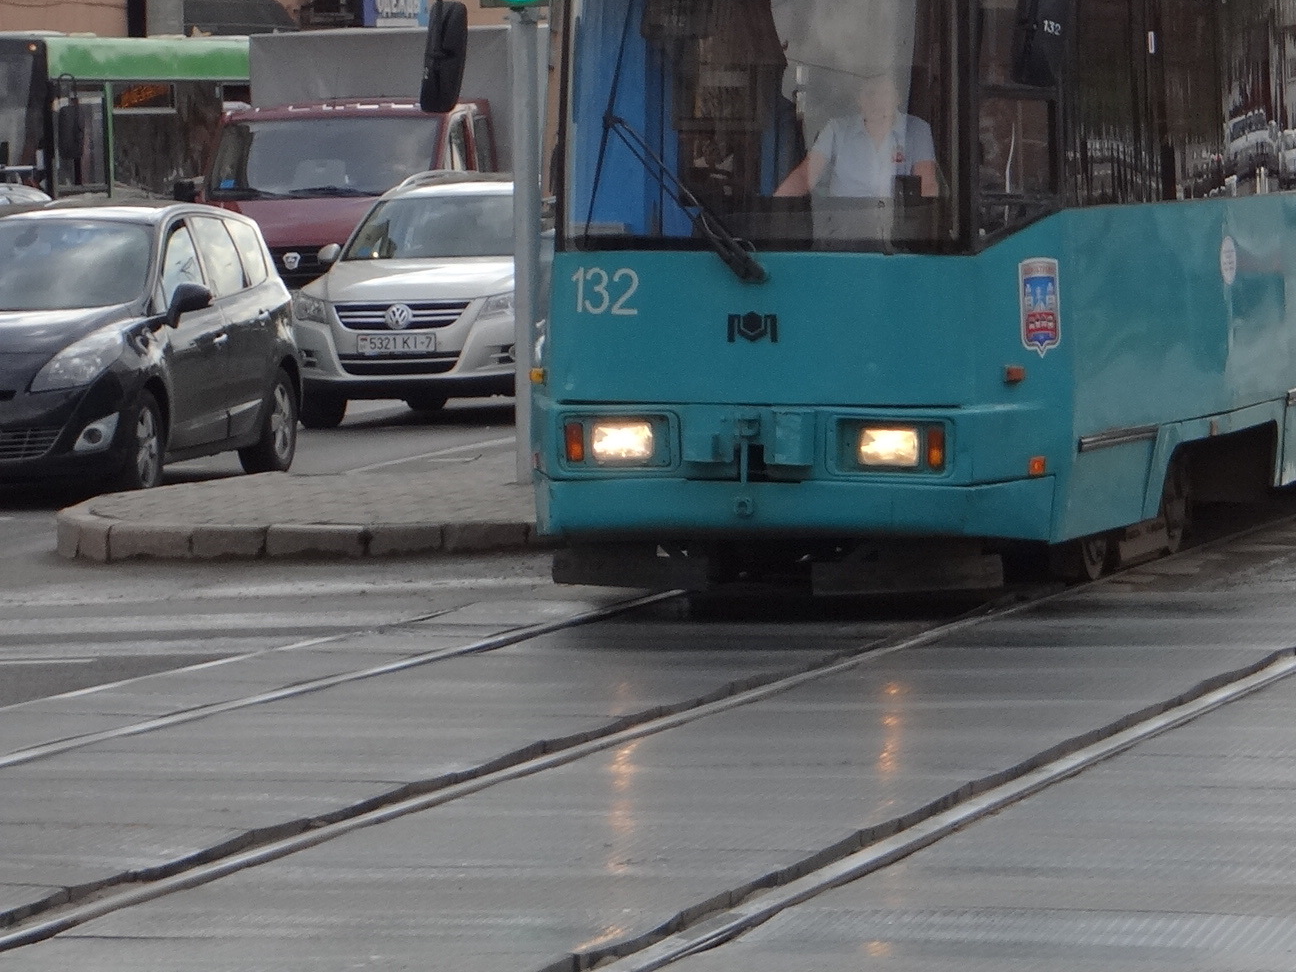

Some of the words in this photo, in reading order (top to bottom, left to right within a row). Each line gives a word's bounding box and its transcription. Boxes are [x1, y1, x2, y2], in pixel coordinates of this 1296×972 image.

[1043, 19, 1061, 36] 132
[571, 266, 639, 316] 132
[369, 337, 397, 350] 5321
